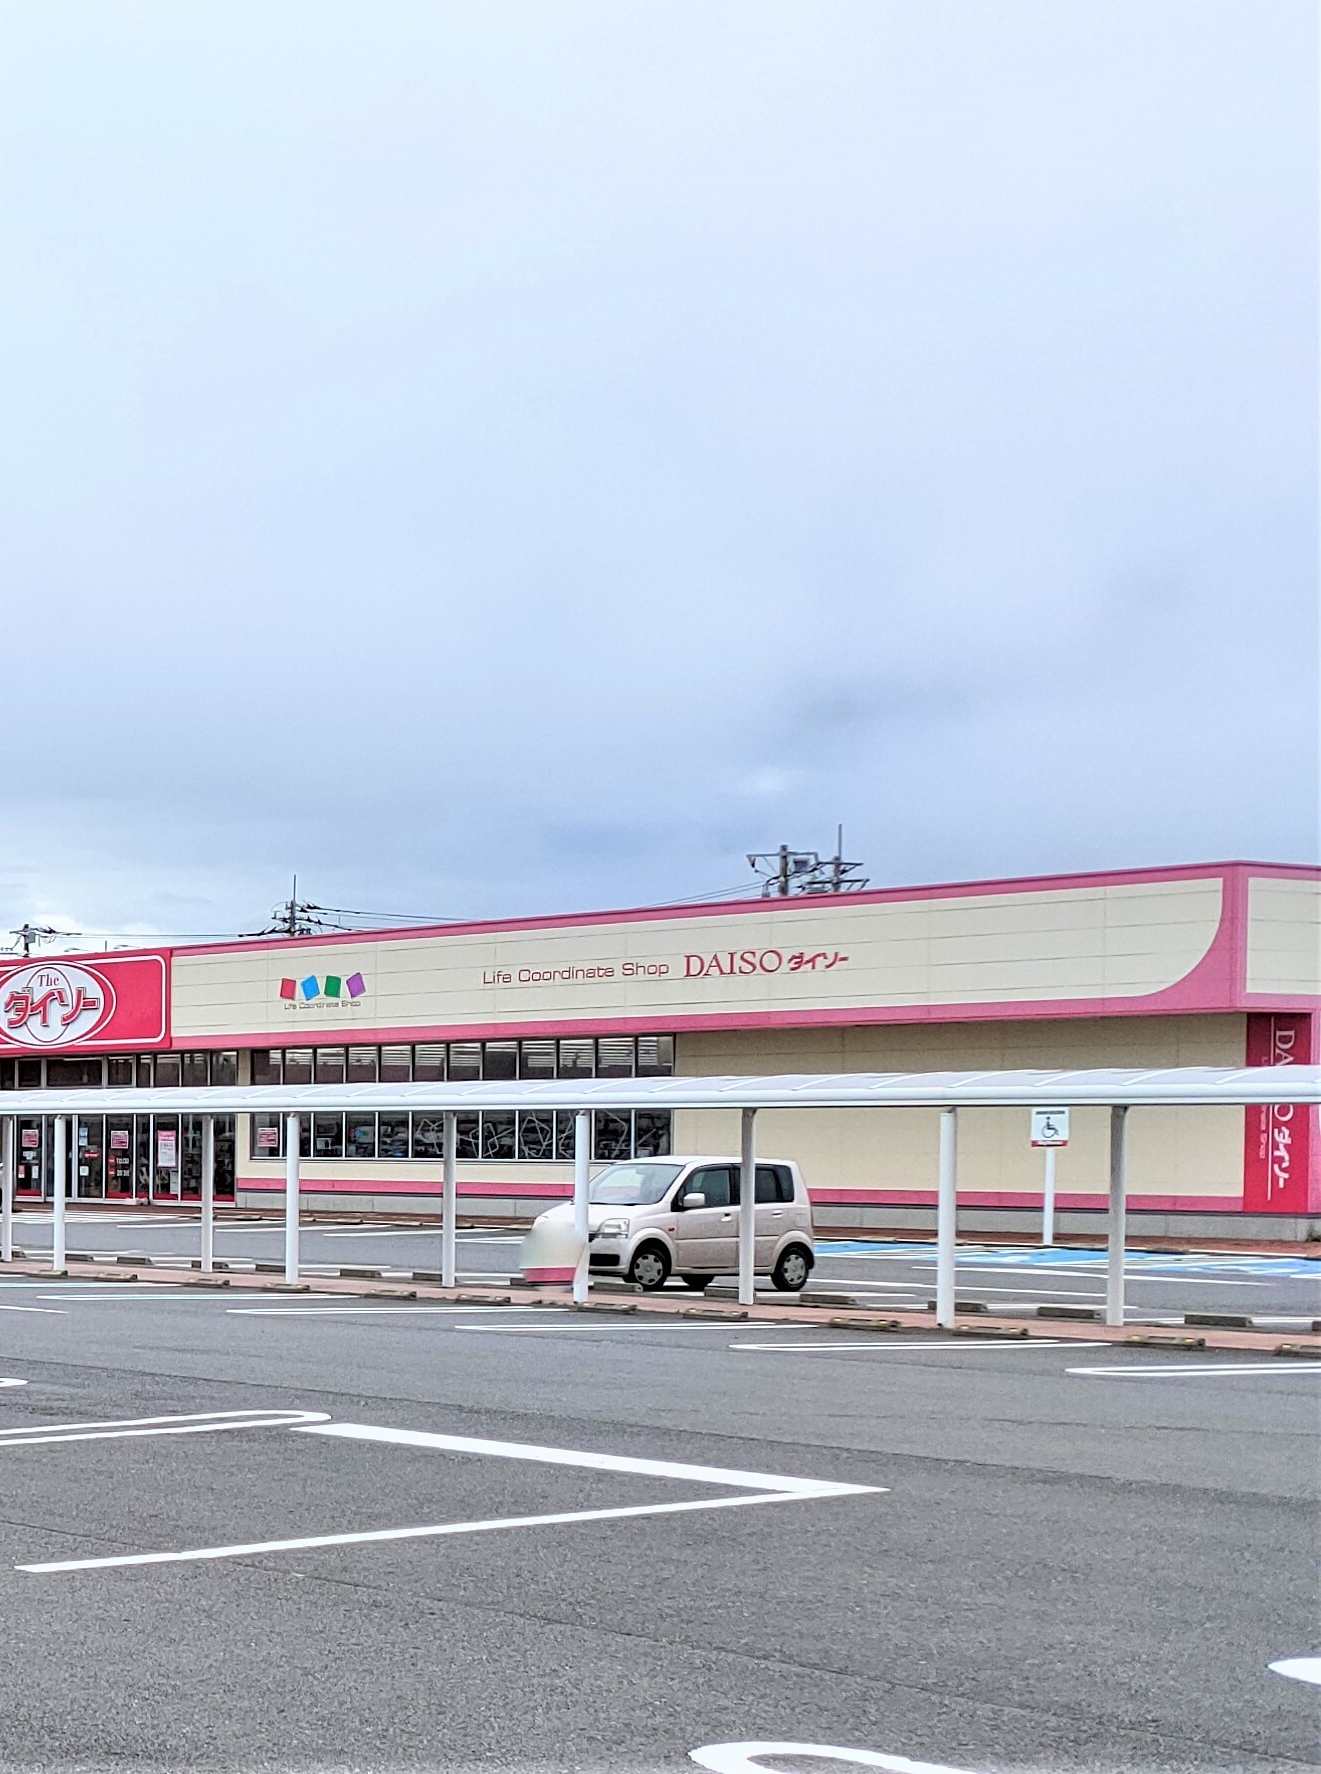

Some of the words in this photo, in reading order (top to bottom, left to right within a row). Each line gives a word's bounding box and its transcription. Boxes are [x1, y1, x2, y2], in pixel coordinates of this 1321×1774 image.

[38, 973, 60, 988] The
[483, 970, 512, 985] Life
[518, 965, 615, 983] Coordinate
[621, 962, 669, 978] Shop
[684, 949, 783, 978] DAISO
[787, 951, 850, 972] ダイソー
[4, 986, 100, 1029] ダイソー
[1273, 1126, 1292, 1188] ダイソー
